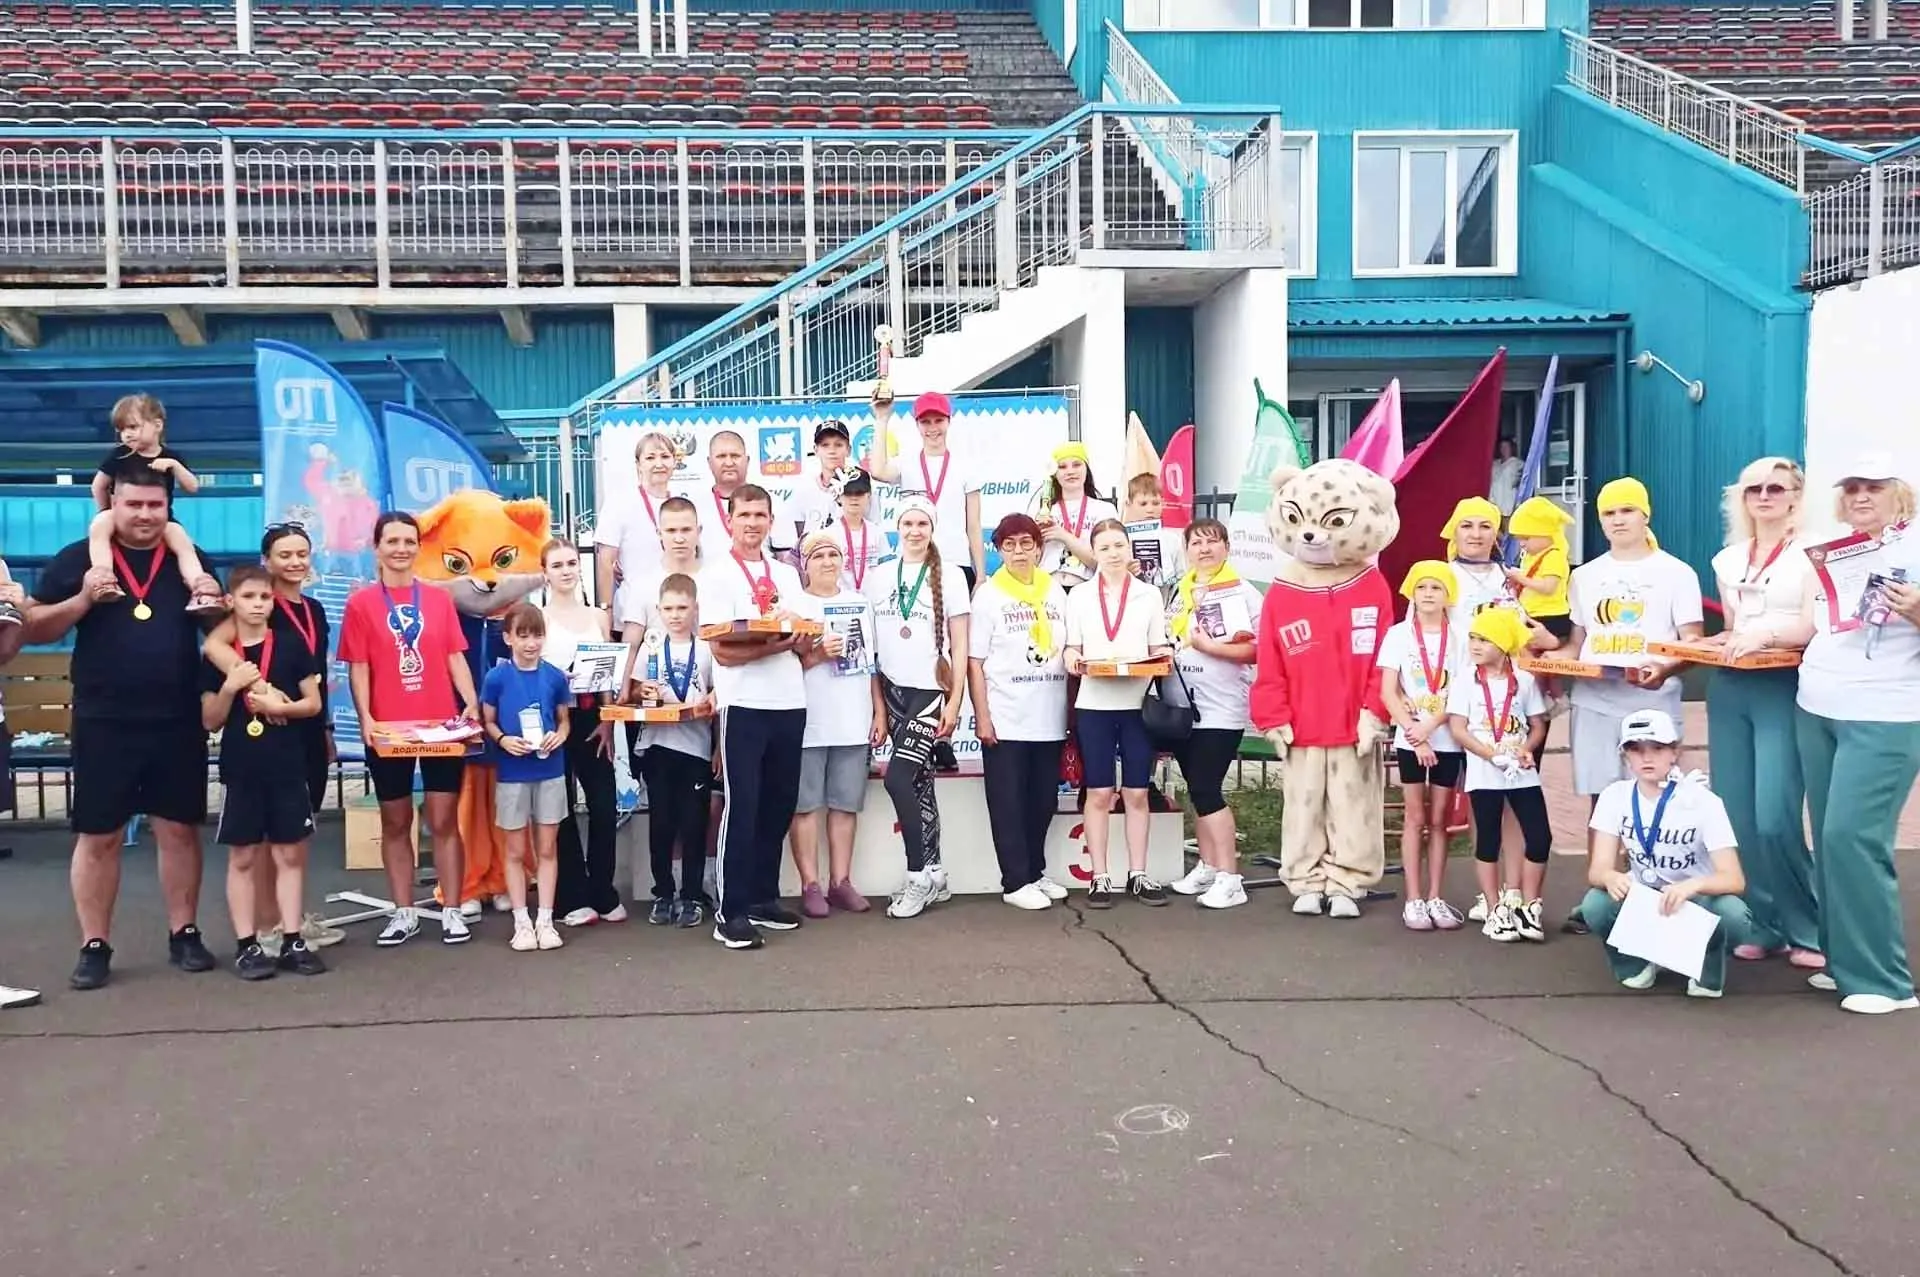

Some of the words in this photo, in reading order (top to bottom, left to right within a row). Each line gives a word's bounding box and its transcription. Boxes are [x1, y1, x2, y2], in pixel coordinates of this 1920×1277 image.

[1833, 544, 1869, 558] ГРАМОТА
[897, 610, 928, 621] СОРТА
[1279, 618, 1312, 650] ГТО
[1529, 660, 1554, 670] ДОДО
[906, 719, 938, 739] Reeb
[392, 746, 418, 755] ДОДО
